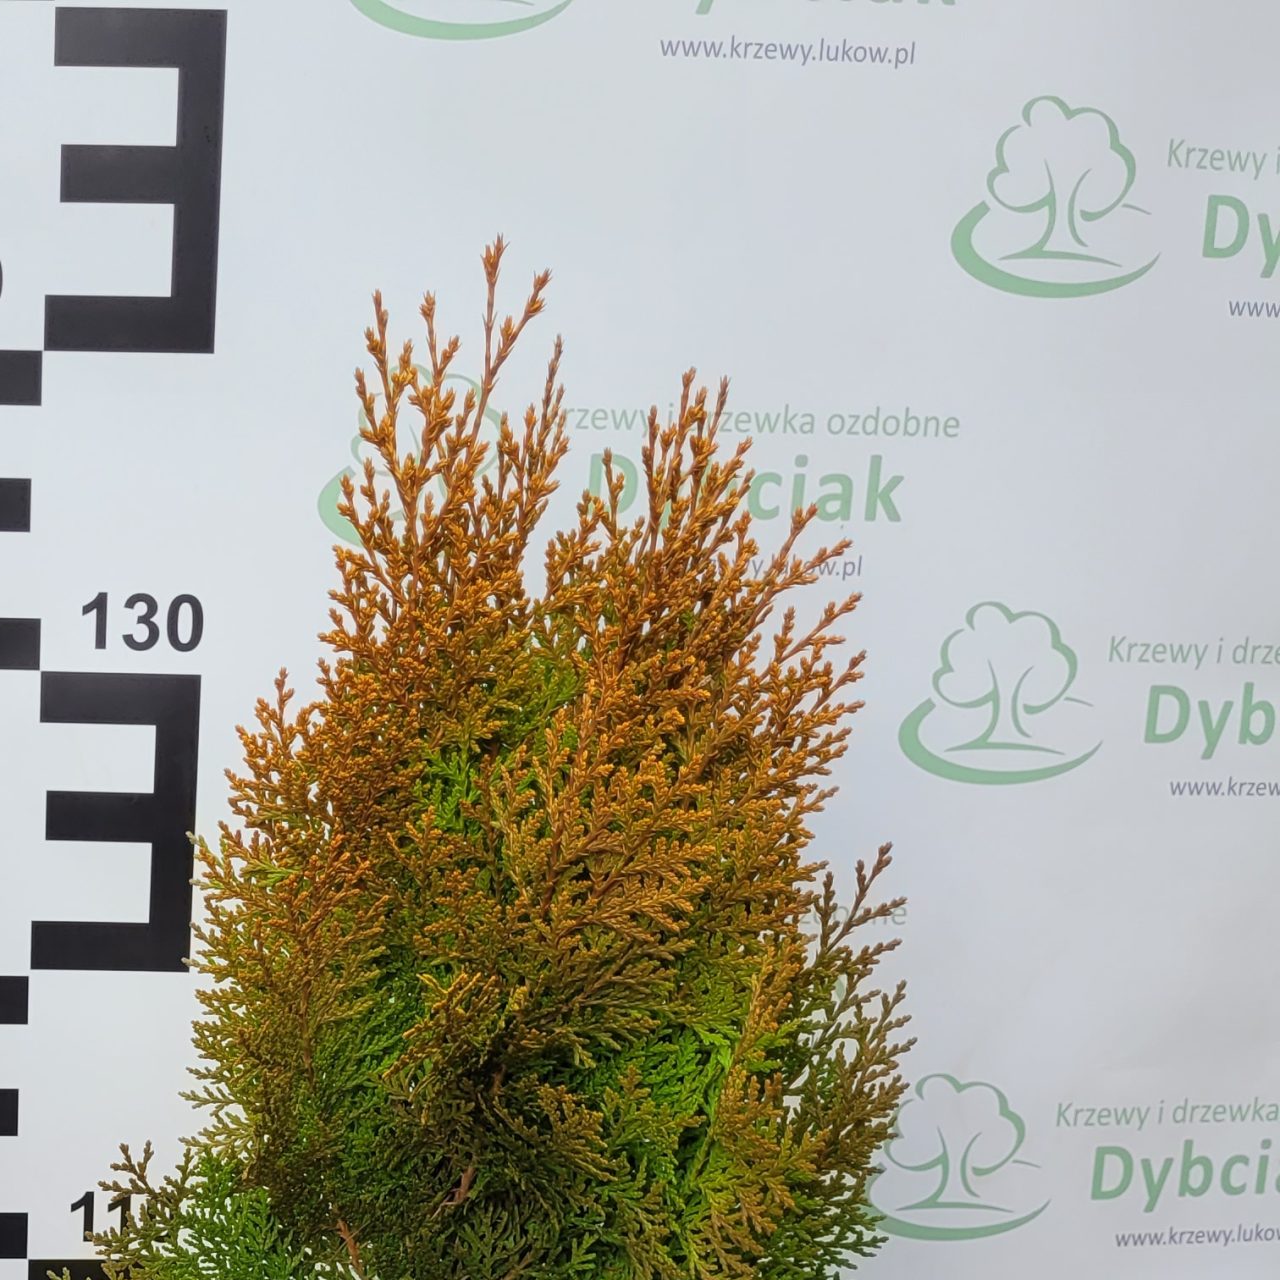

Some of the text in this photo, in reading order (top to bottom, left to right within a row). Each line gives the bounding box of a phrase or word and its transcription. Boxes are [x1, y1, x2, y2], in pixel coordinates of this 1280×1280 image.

[660, 35, 916, 69] www.krzewy.lukow.pl
[1167, 138, 1268, 181] Krzewy
[826, 407, 960, 438] ozdobne
[81, 591, 204, 652] 130
[1108, 636, 1208, 671] Krzewy
[1216, 637, 1224, 664] i
[1056, 1096, 1280, 1131] Krzewy i drzewka
